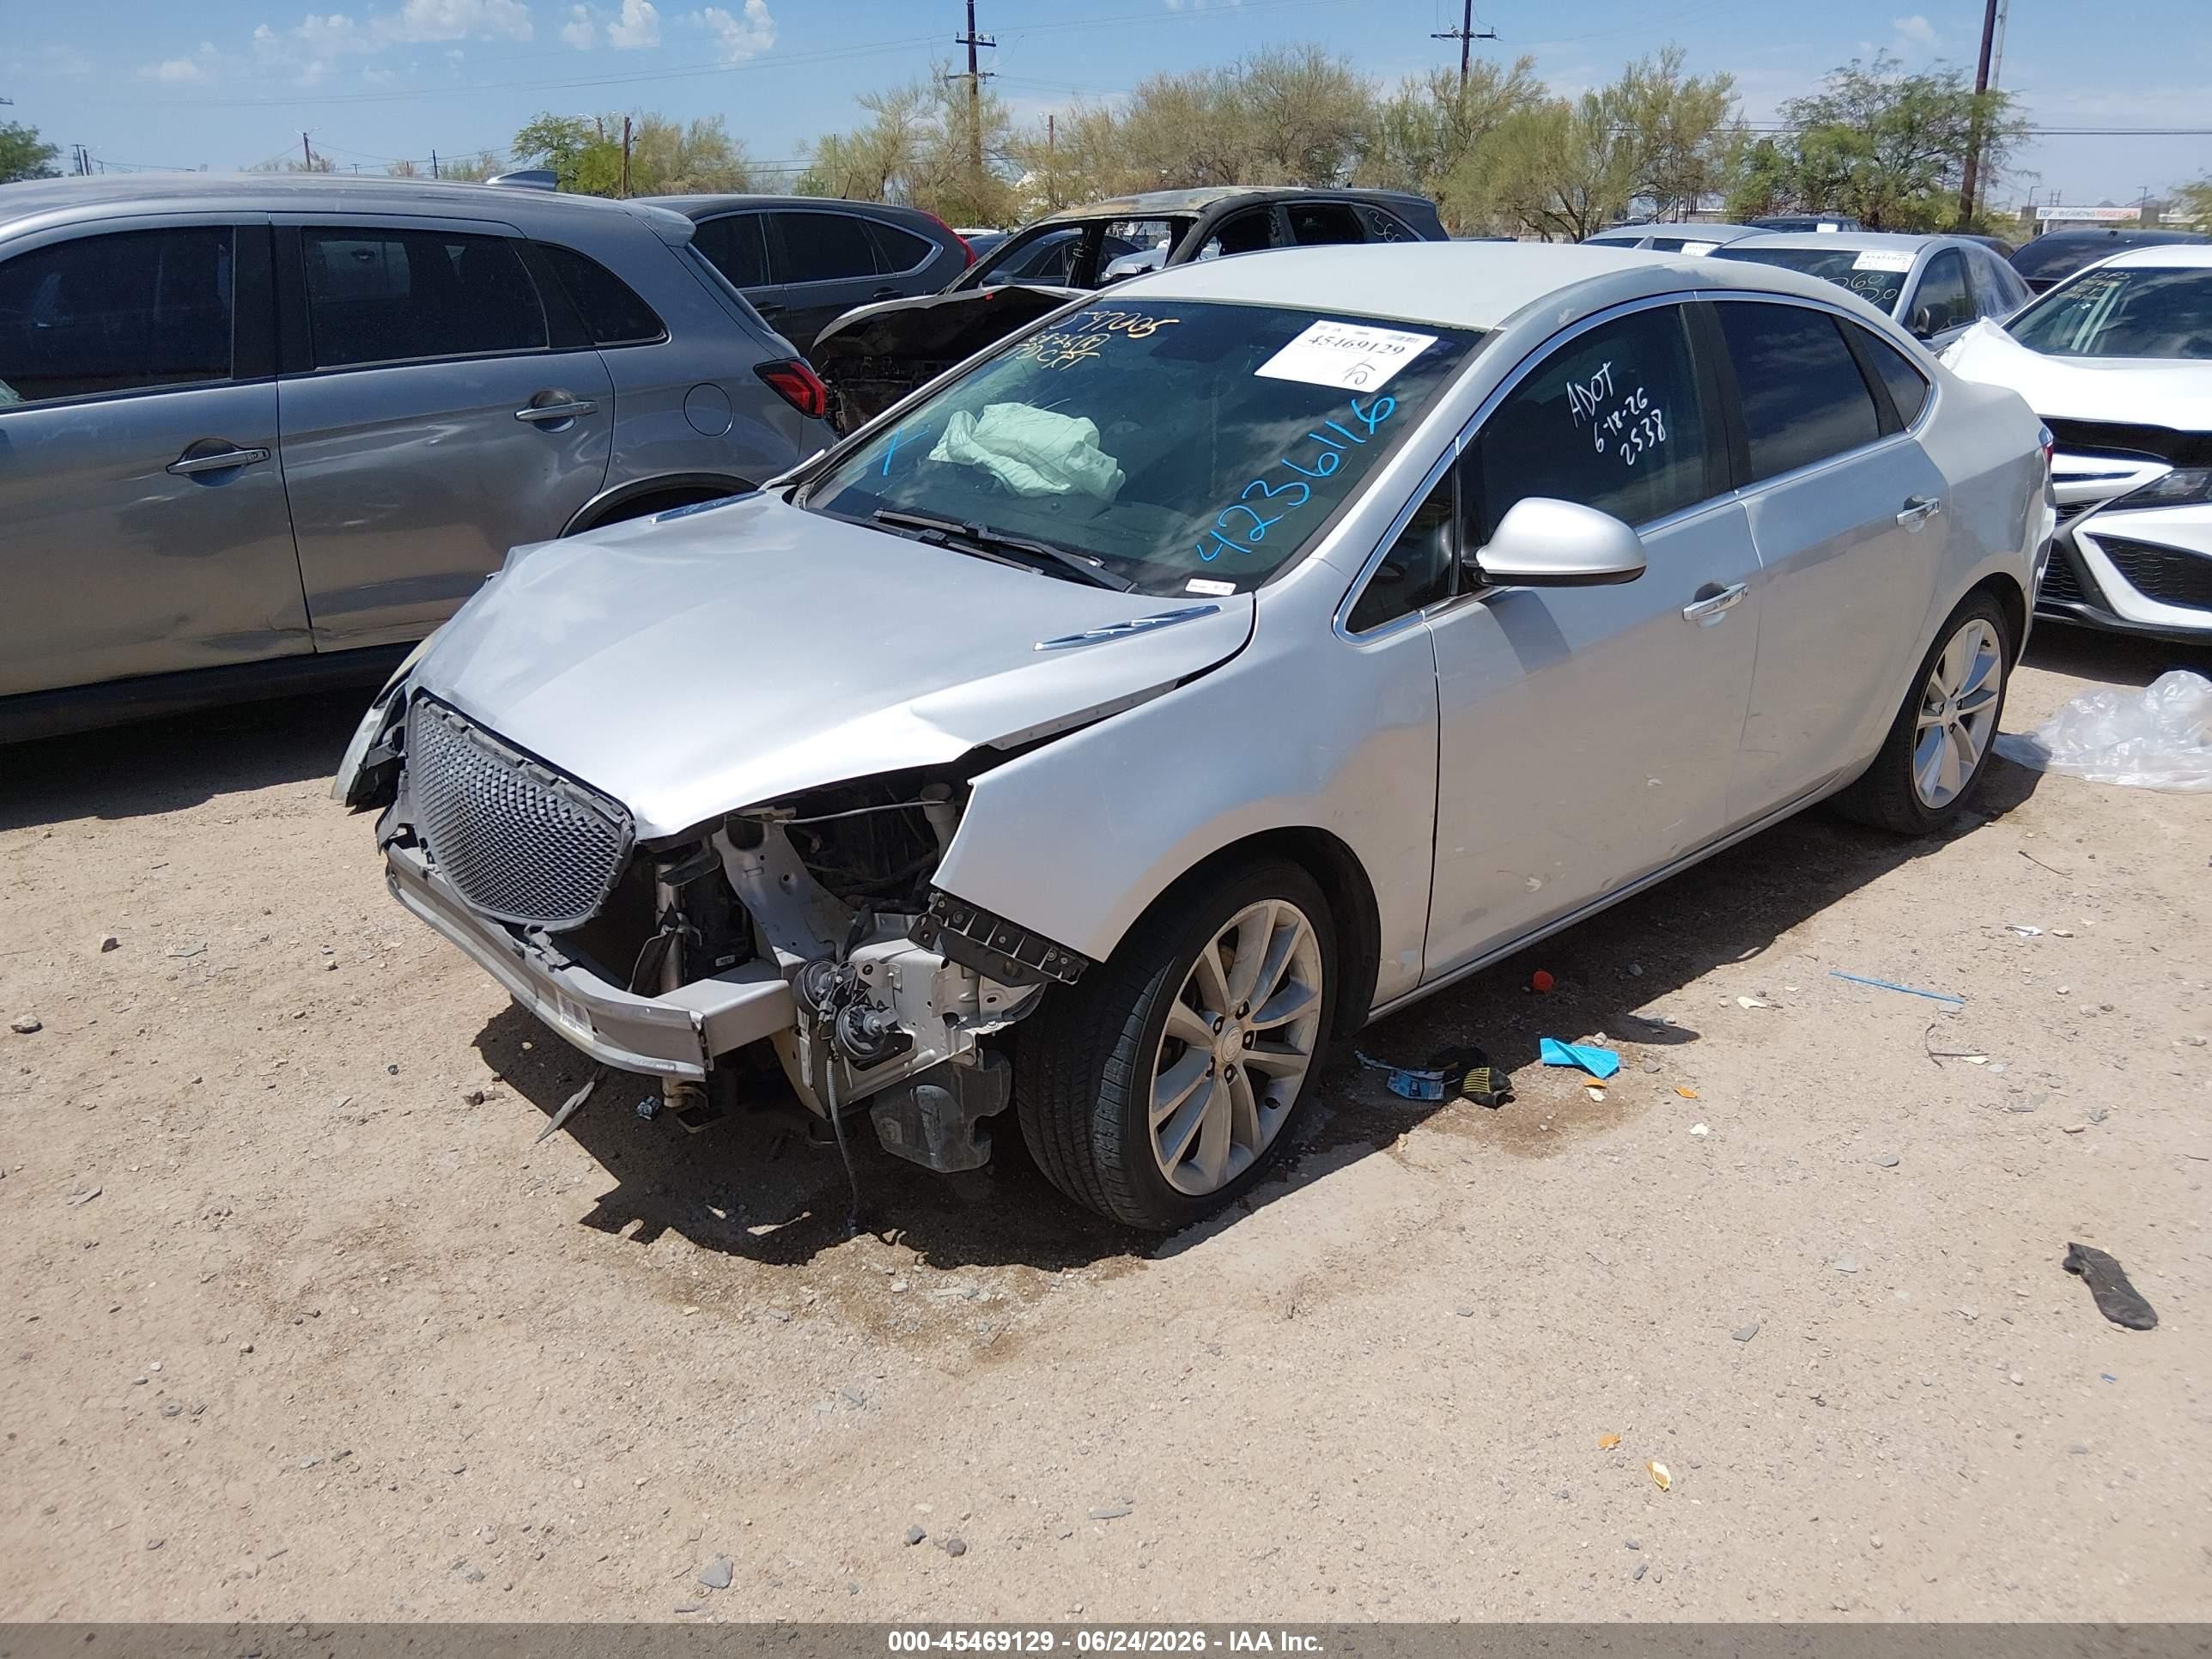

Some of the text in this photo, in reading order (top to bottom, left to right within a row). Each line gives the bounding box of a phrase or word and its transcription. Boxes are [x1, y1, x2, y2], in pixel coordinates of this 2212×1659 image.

[1308, 334, 1407, 356] 45469129
[1565, 361, 1613, 428] ADOT
[1620, 408, 1667, 466] 2538
[1195, 395, 1396, 562] 4236116
